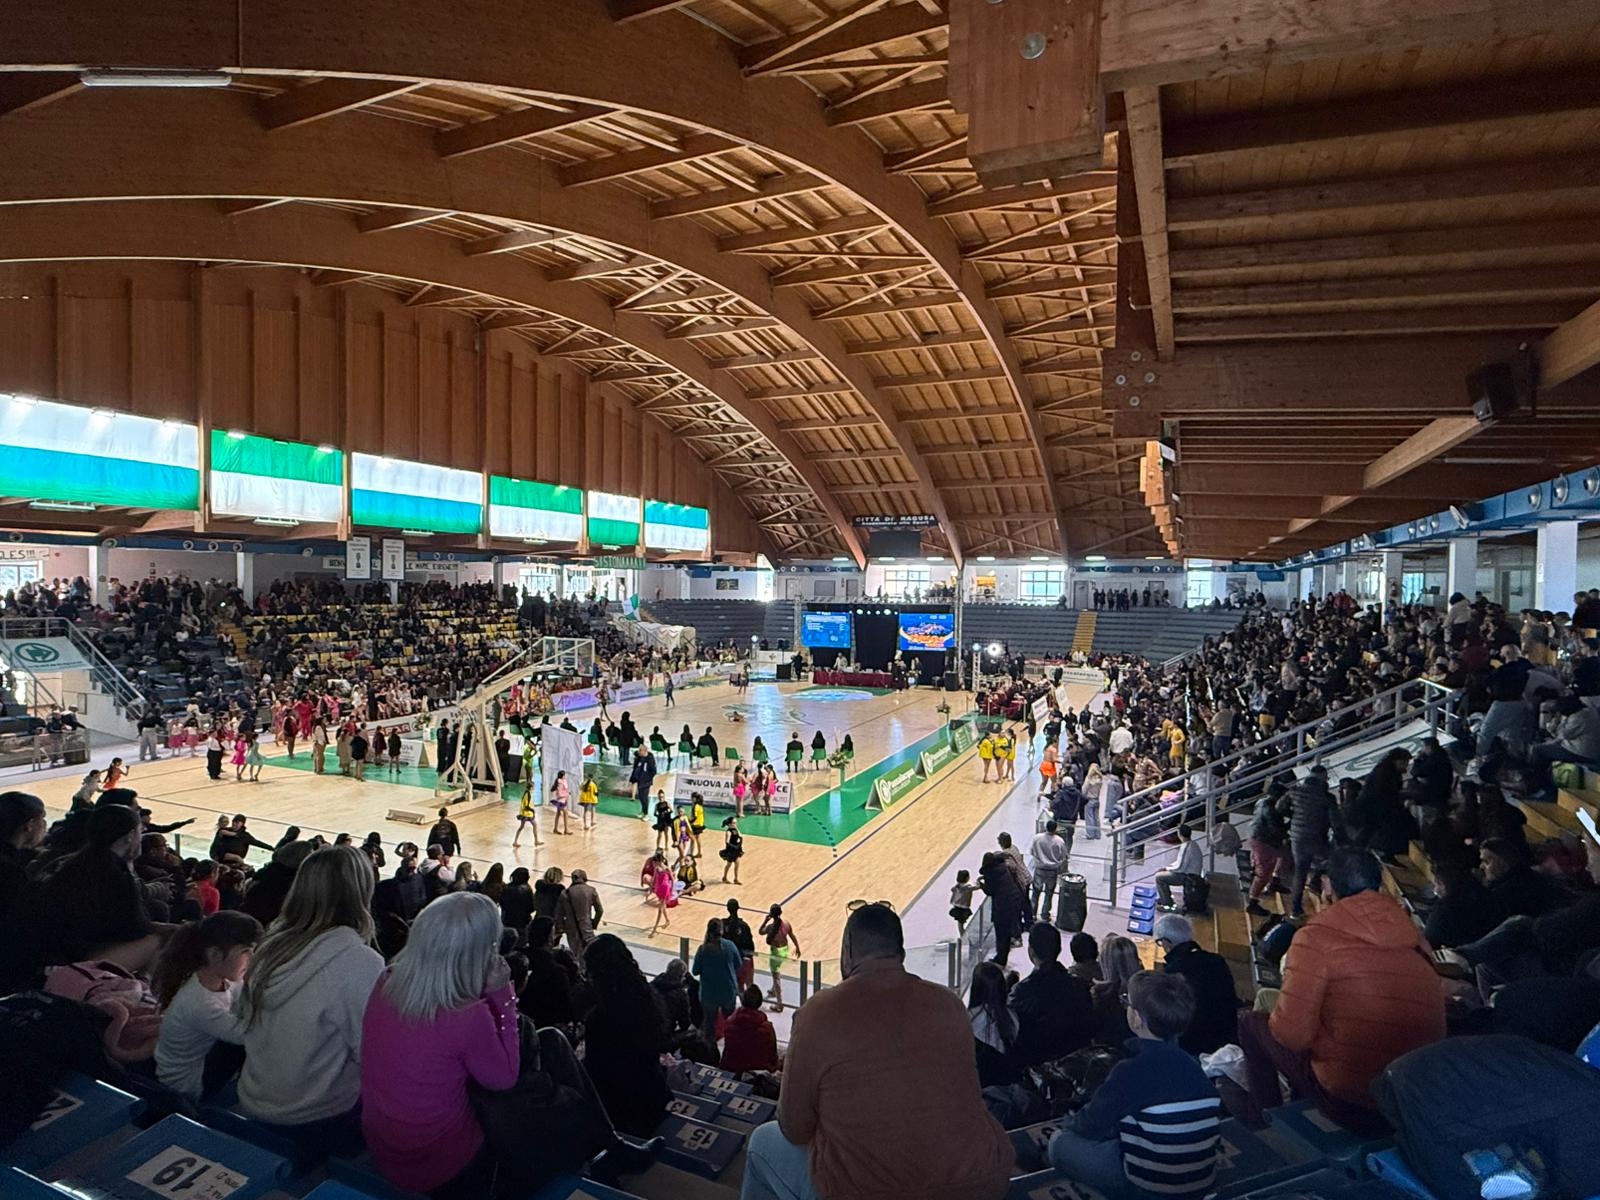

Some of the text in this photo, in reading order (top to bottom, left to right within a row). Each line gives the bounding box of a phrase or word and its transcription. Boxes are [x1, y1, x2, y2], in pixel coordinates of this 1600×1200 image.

[689, 779, 721, 788] NUOVA
[738, 1099, 755, 1110] 11
[689, 1128, 713, 1145] 15
[151, 1156, 212, 1192] 19
